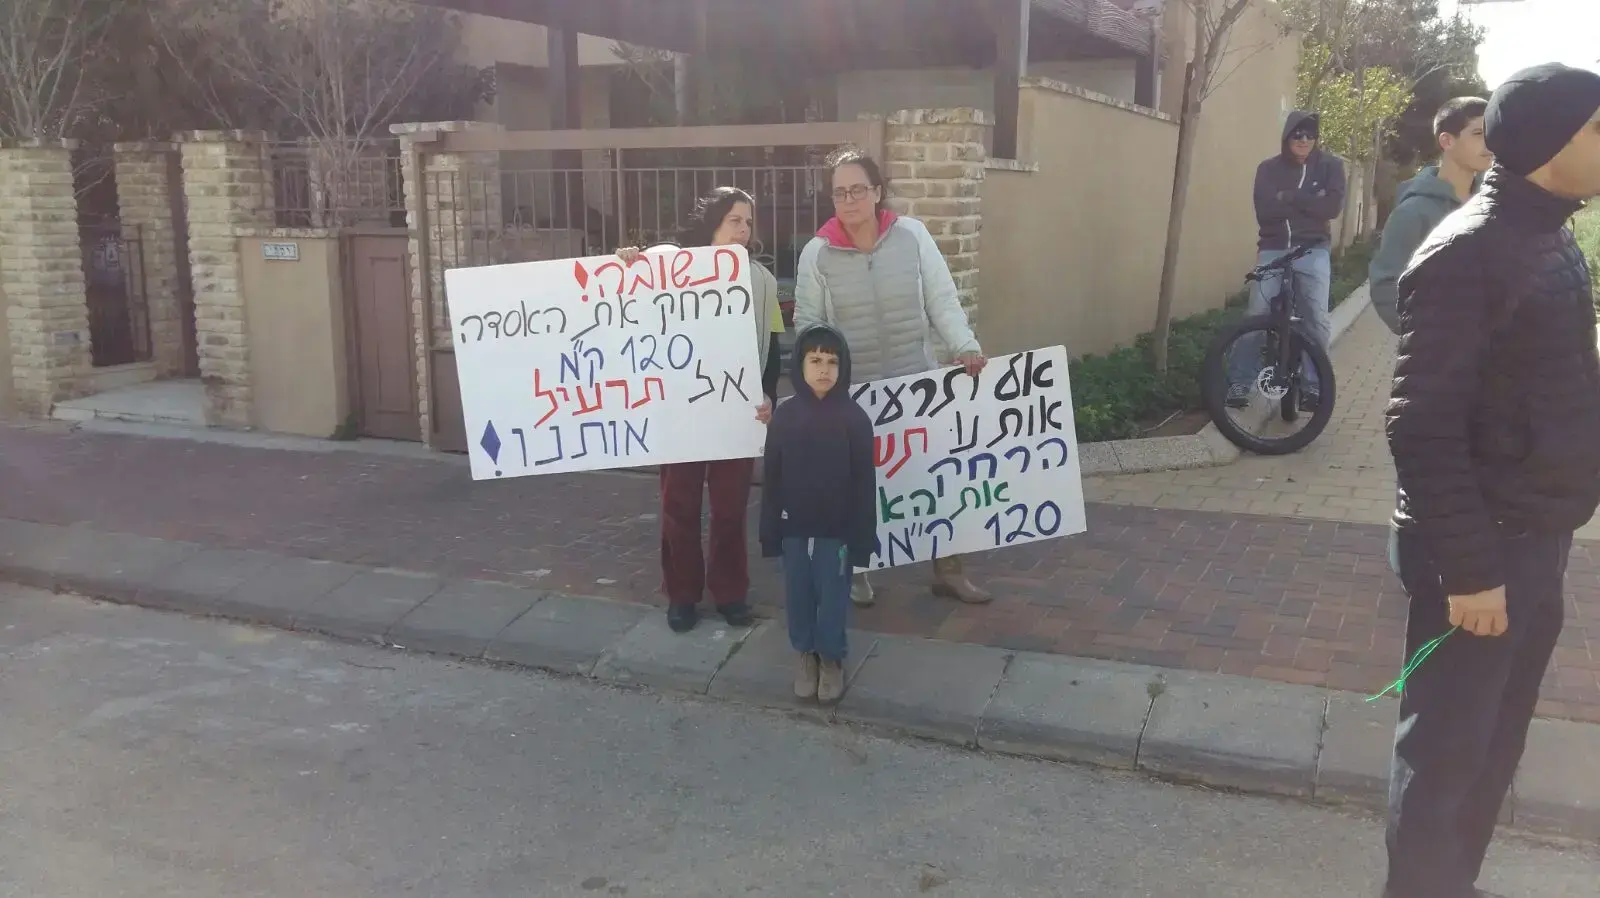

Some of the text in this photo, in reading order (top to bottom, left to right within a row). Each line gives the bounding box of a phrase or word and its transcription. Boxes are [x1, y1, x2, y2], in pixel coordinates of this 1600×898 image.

[460, 286, 750, 343] הרחק את האסדה
[620, 334, 694, 373] 120
[994, 351, 1054, 402] אל
[533, 359, 750, 429] אל תרעיל
[927, 437, 1068, 498] הרחק
[949, 480, 1010, 521] את
[984, 500, 1062, 546] 120
